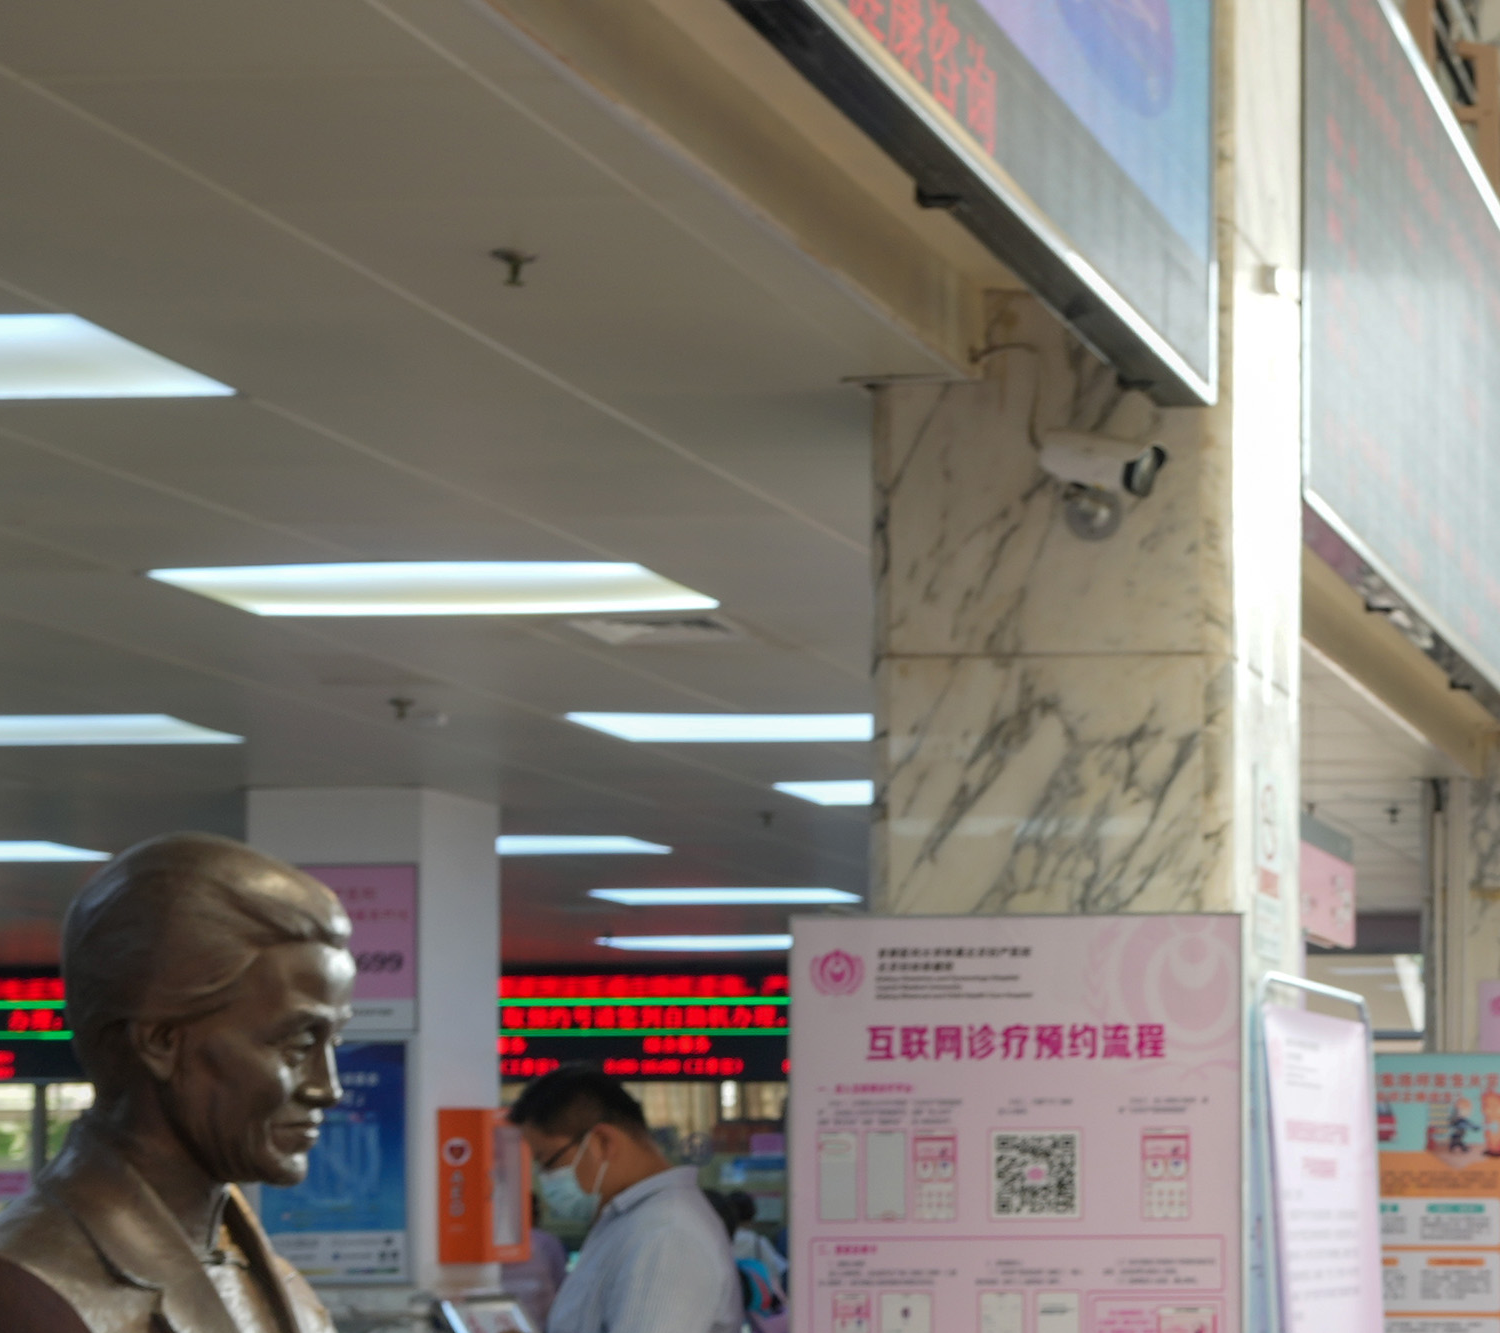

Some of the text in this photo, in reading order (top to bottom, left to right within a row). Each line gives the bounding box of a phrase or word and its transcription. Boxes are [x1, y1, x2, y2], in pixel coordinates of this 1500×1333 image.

[865, 1024, 1167, 1060] 互联网诊疗预约流程
